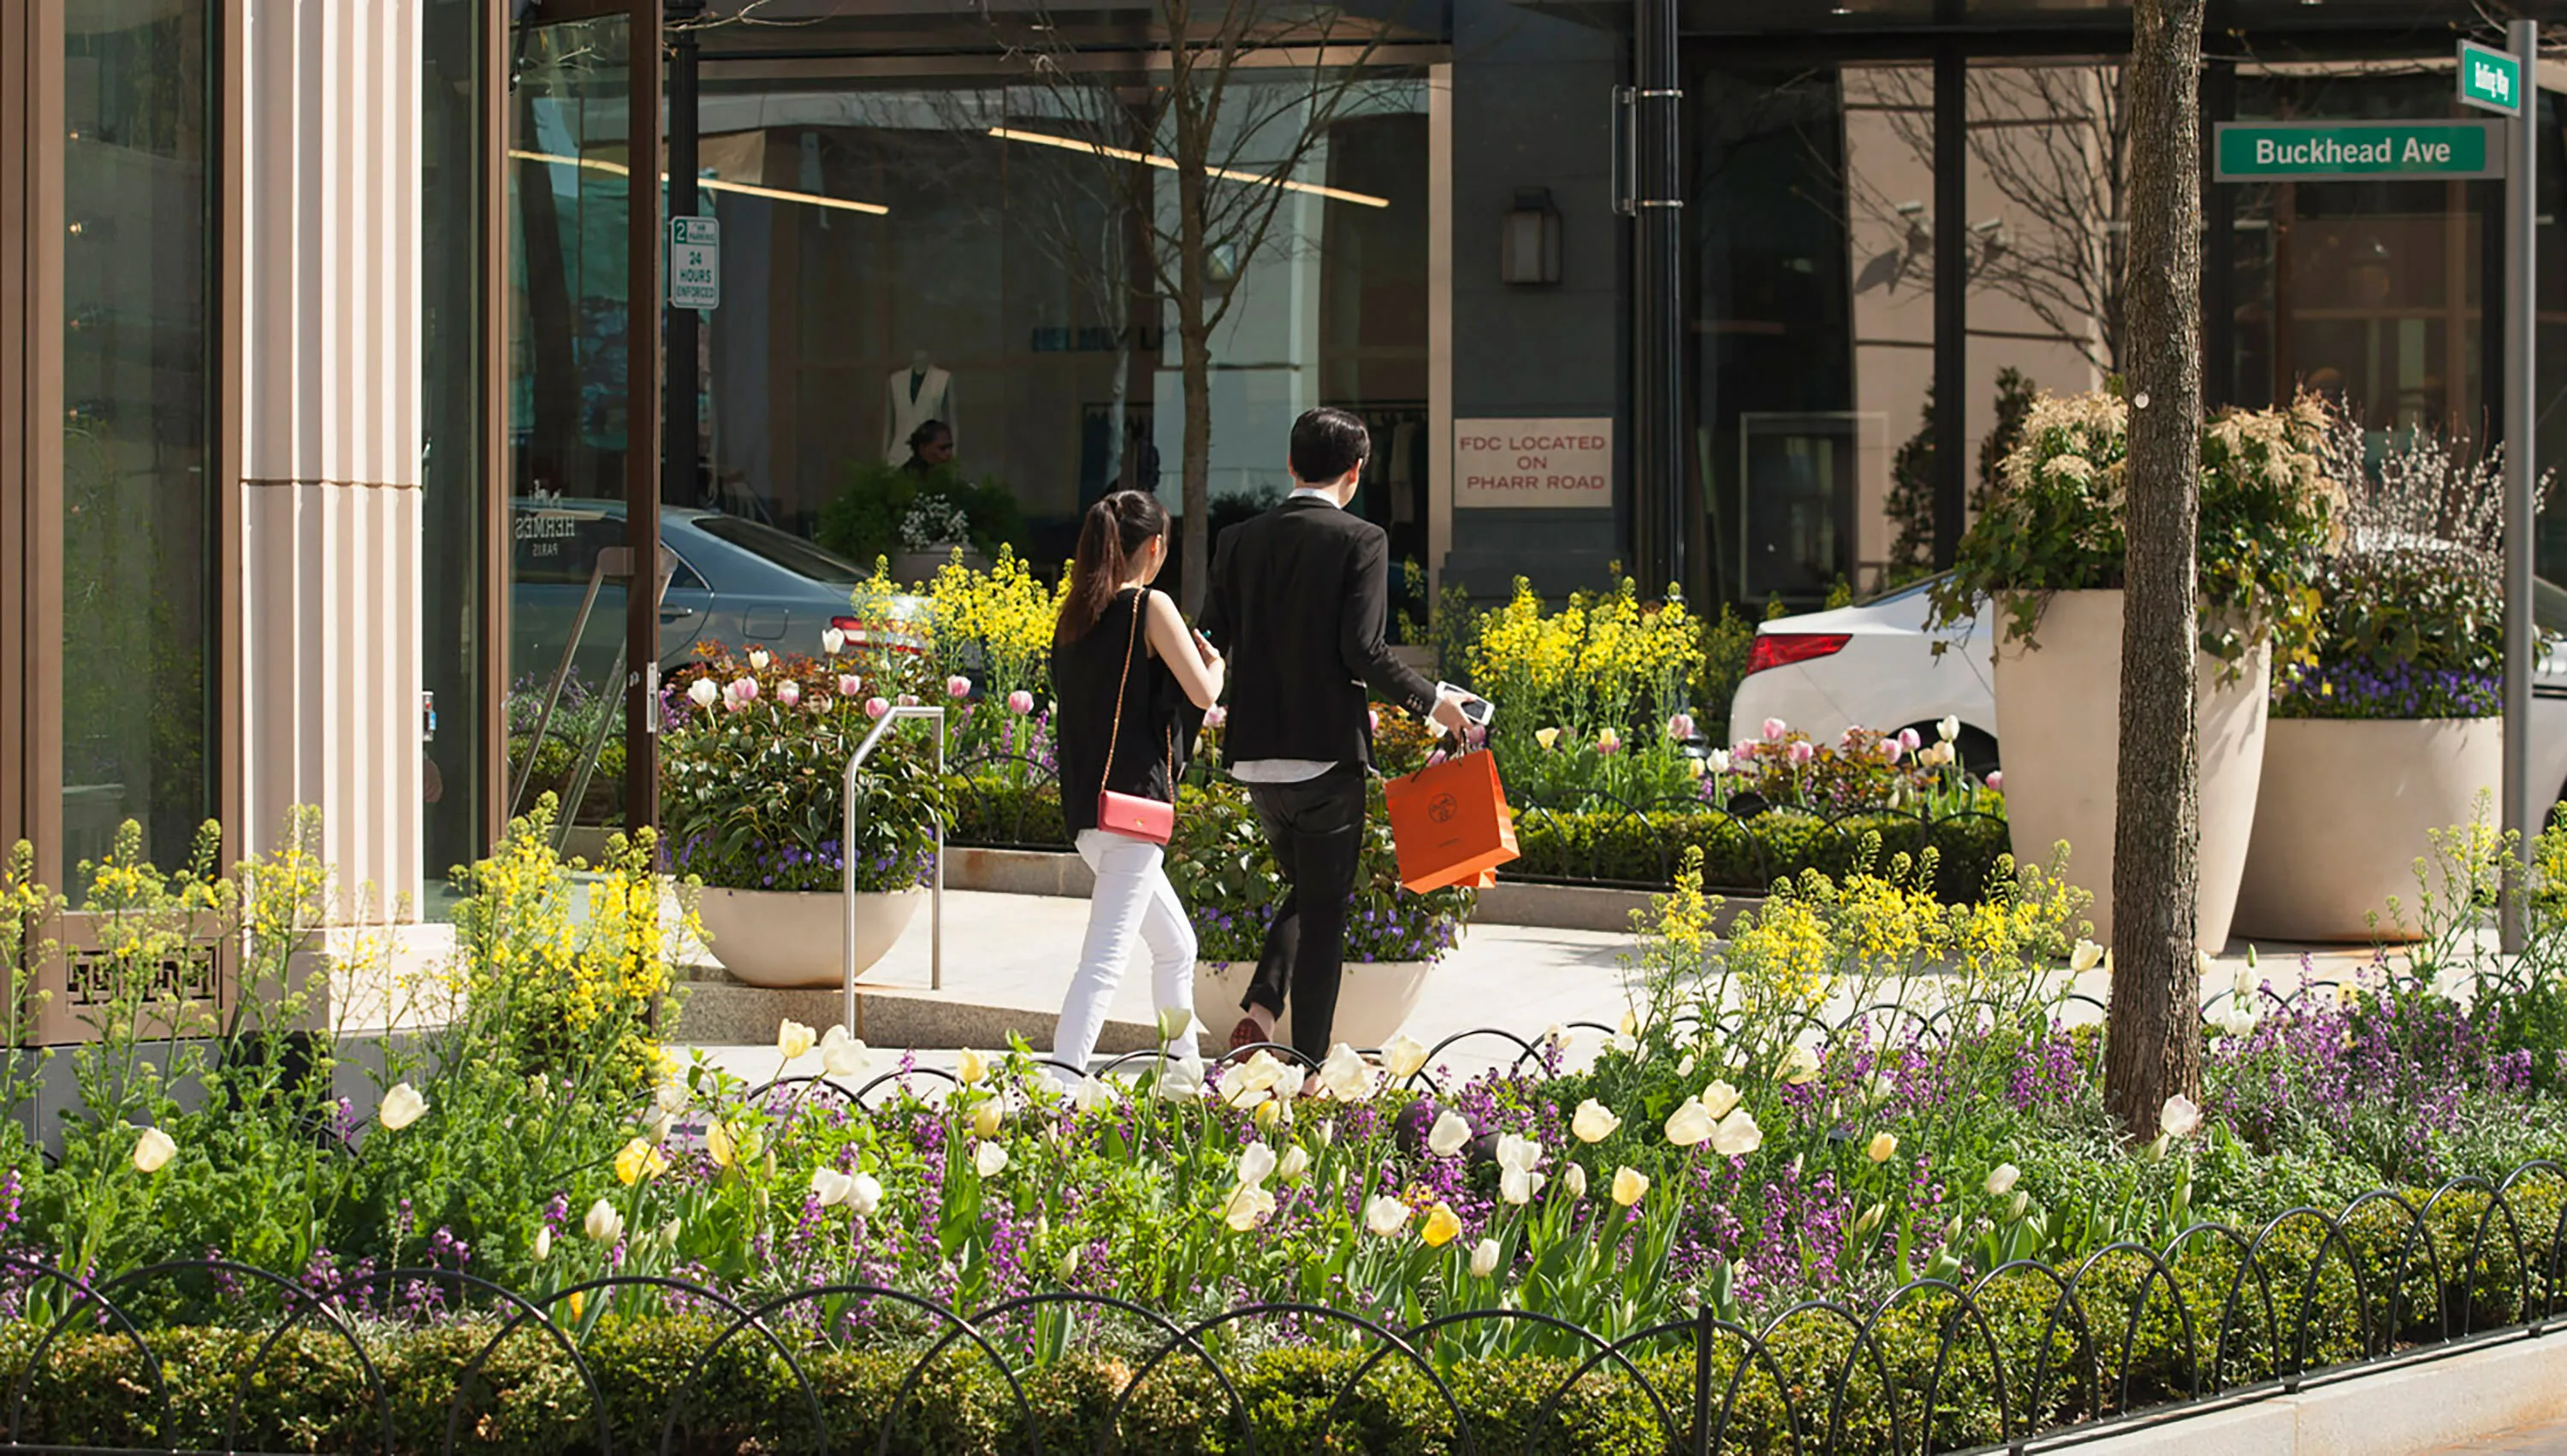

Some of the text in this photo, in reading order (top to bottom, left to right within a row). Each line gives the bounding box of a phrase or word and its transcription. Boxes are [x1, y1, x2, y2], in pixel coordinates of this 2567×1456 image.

[2256, 137, 2451, 164] Buckhead Ave
[676, 222, 686, 241] 2
[689, 251, 702, 265] 24
[679, 269, 713, 284] HOURS
[676, 284, 715, 299] ENFORCED
[1460, 435, 1606, 451] FDC LOCATED
[1516, 456, 1548, 471] ON
[1467, 475, 1605, 489] PHARR ROAD
